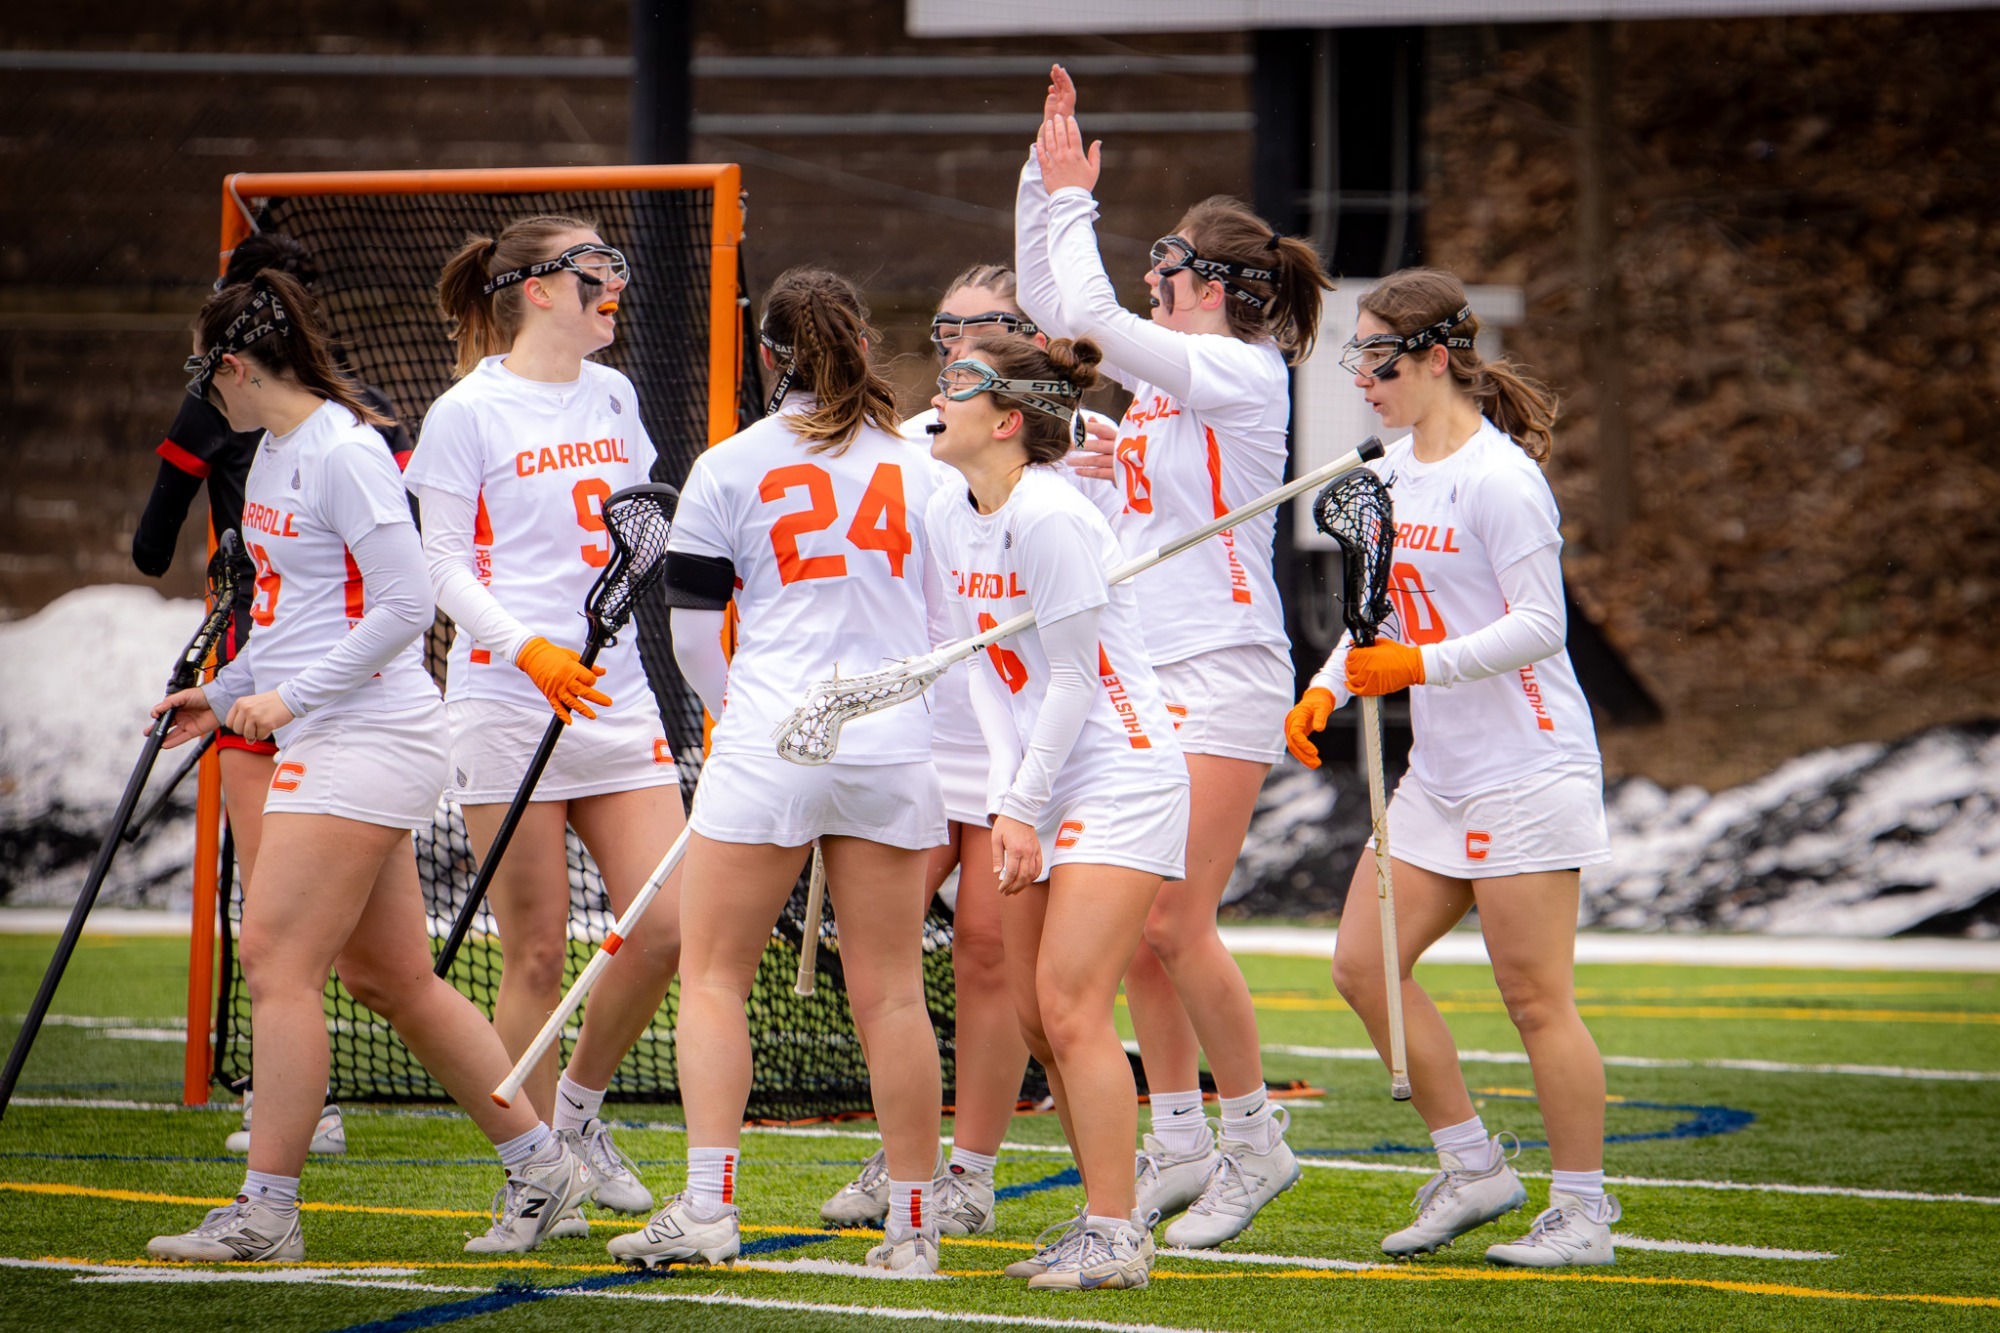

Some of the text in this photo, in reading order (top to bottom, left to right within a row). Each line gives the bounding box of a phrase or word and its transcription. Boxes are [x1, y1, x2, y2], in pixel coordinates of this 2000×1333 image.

[496, 259, 563, 286] STX STX
[1193, 259, 1272, 280] STX STX
[1235, 290, 1264, 309] STX
[201, 341, 223, 370] STX
[225, 311, 251, 340] STX
[243, 321, 275, 345] STX
[774, 344, 796, 354] GAI
[1447, 338, 1471, 348] STX
[765, 401, 779, 419] AIT
[774, 376, 791, 400] GAIT
[991, 380, 1011, 390] TX
[515, 437, 629, 478] CARROLL
[241, 501, 299, 537] ARROLL
[571, 477, 613, 568] 9
[758, 462, 912, 587] 24
[1102, 676, 1142, 734] HUSTLE
[1519, 664, 1547, 715] HUSTL
[270, 760, 307, 793] C
[1054, 820, 1086, 850] C
[1465, 830, 1493, 861] C
